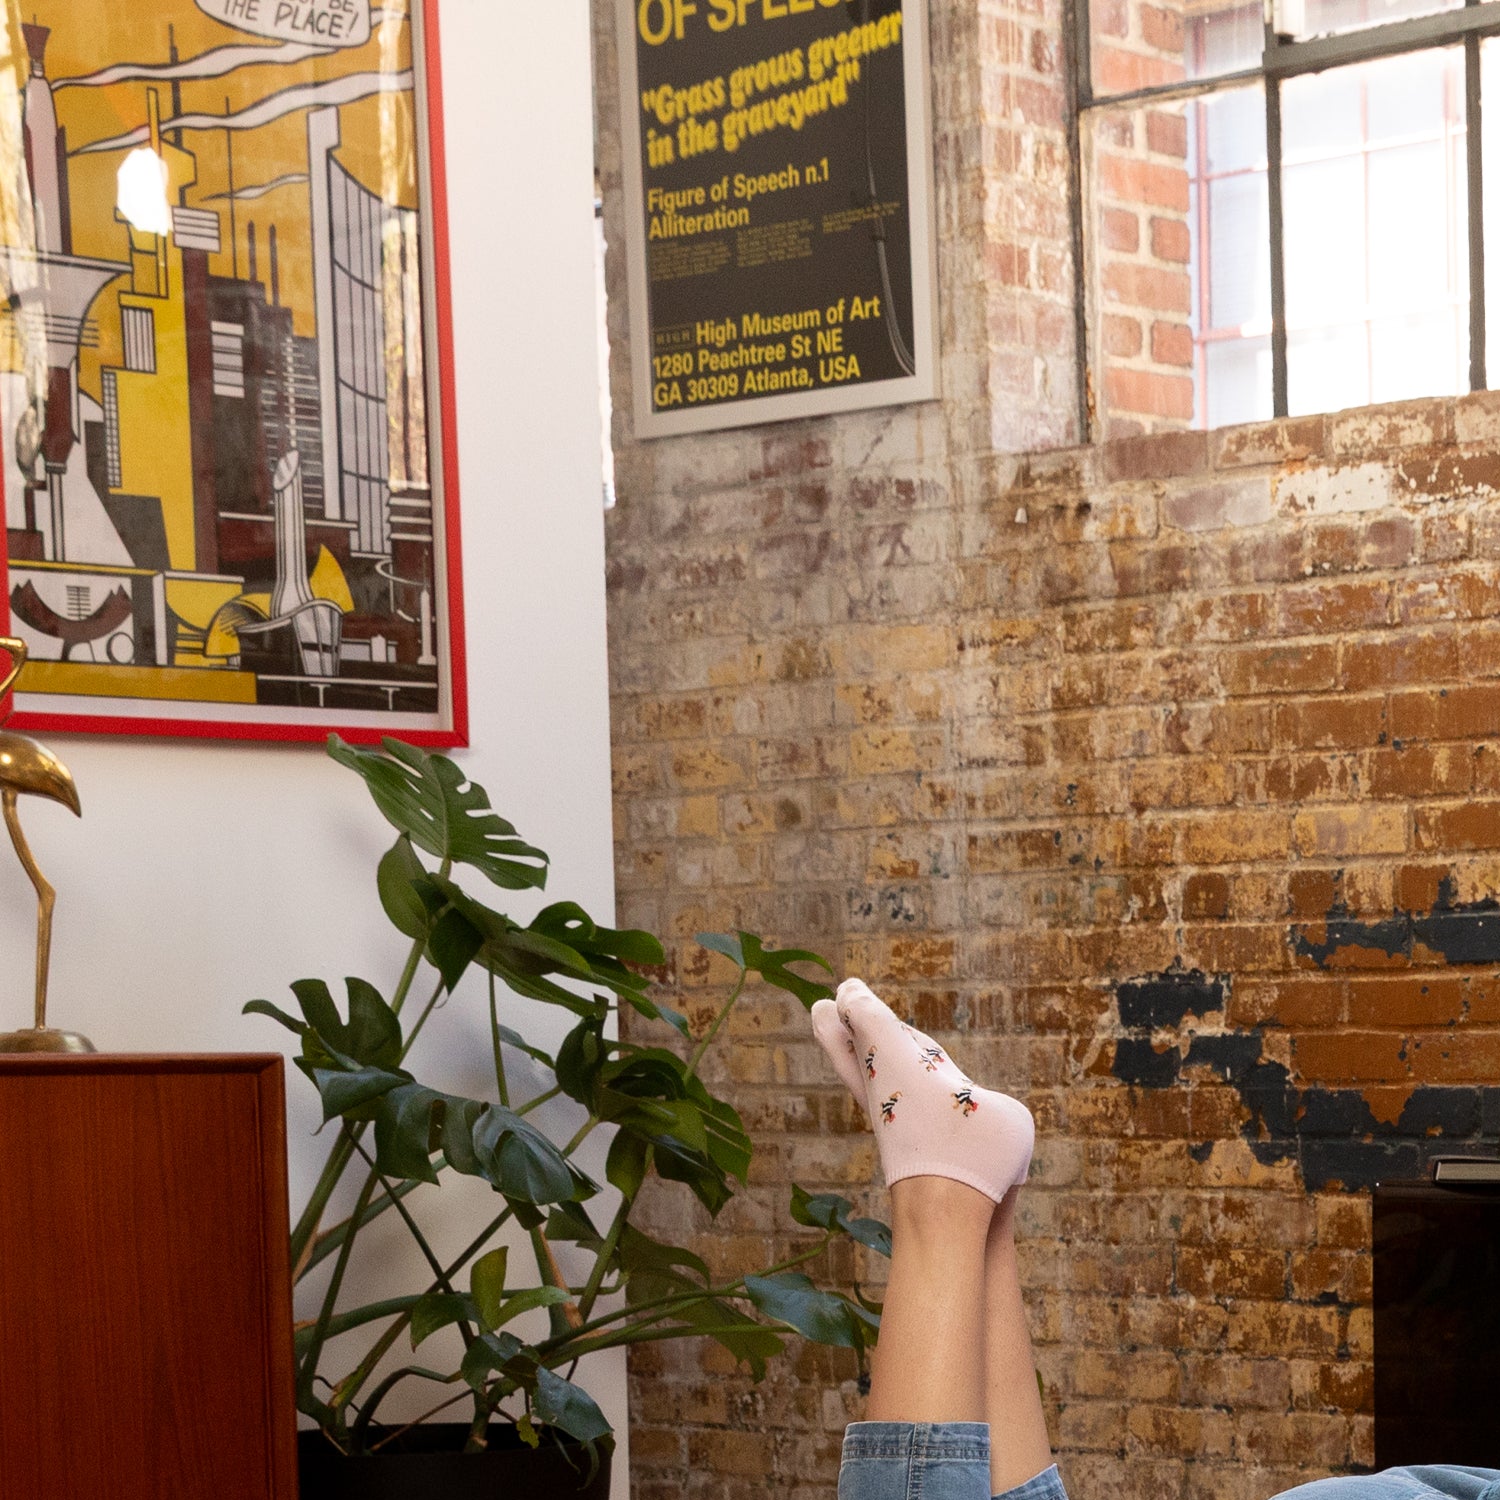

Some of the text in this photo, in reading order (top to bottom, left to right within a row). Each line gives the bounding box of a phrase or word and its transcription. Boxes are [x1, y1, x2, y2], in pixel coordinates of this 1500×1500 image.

[223, 0, 360, 38] THE PLACE!
[638, 0, 698, 46] OF
[730, 48, 803, 108] grows
[808, 11, 902, 81] greener
[647, 128, 674, 168] in
[677, 116, 718, 158] the
[648, 157, 830, 214] Figure of Speech n.1
[648, 205, 749, 241] Alliteration
[695, 295, 881, 348] High Museum of Art
[652, 328, 843, 379] 1280 Peachtree St NE
[653, 353, 861, 407] GA 30309 Atlanta, USA
